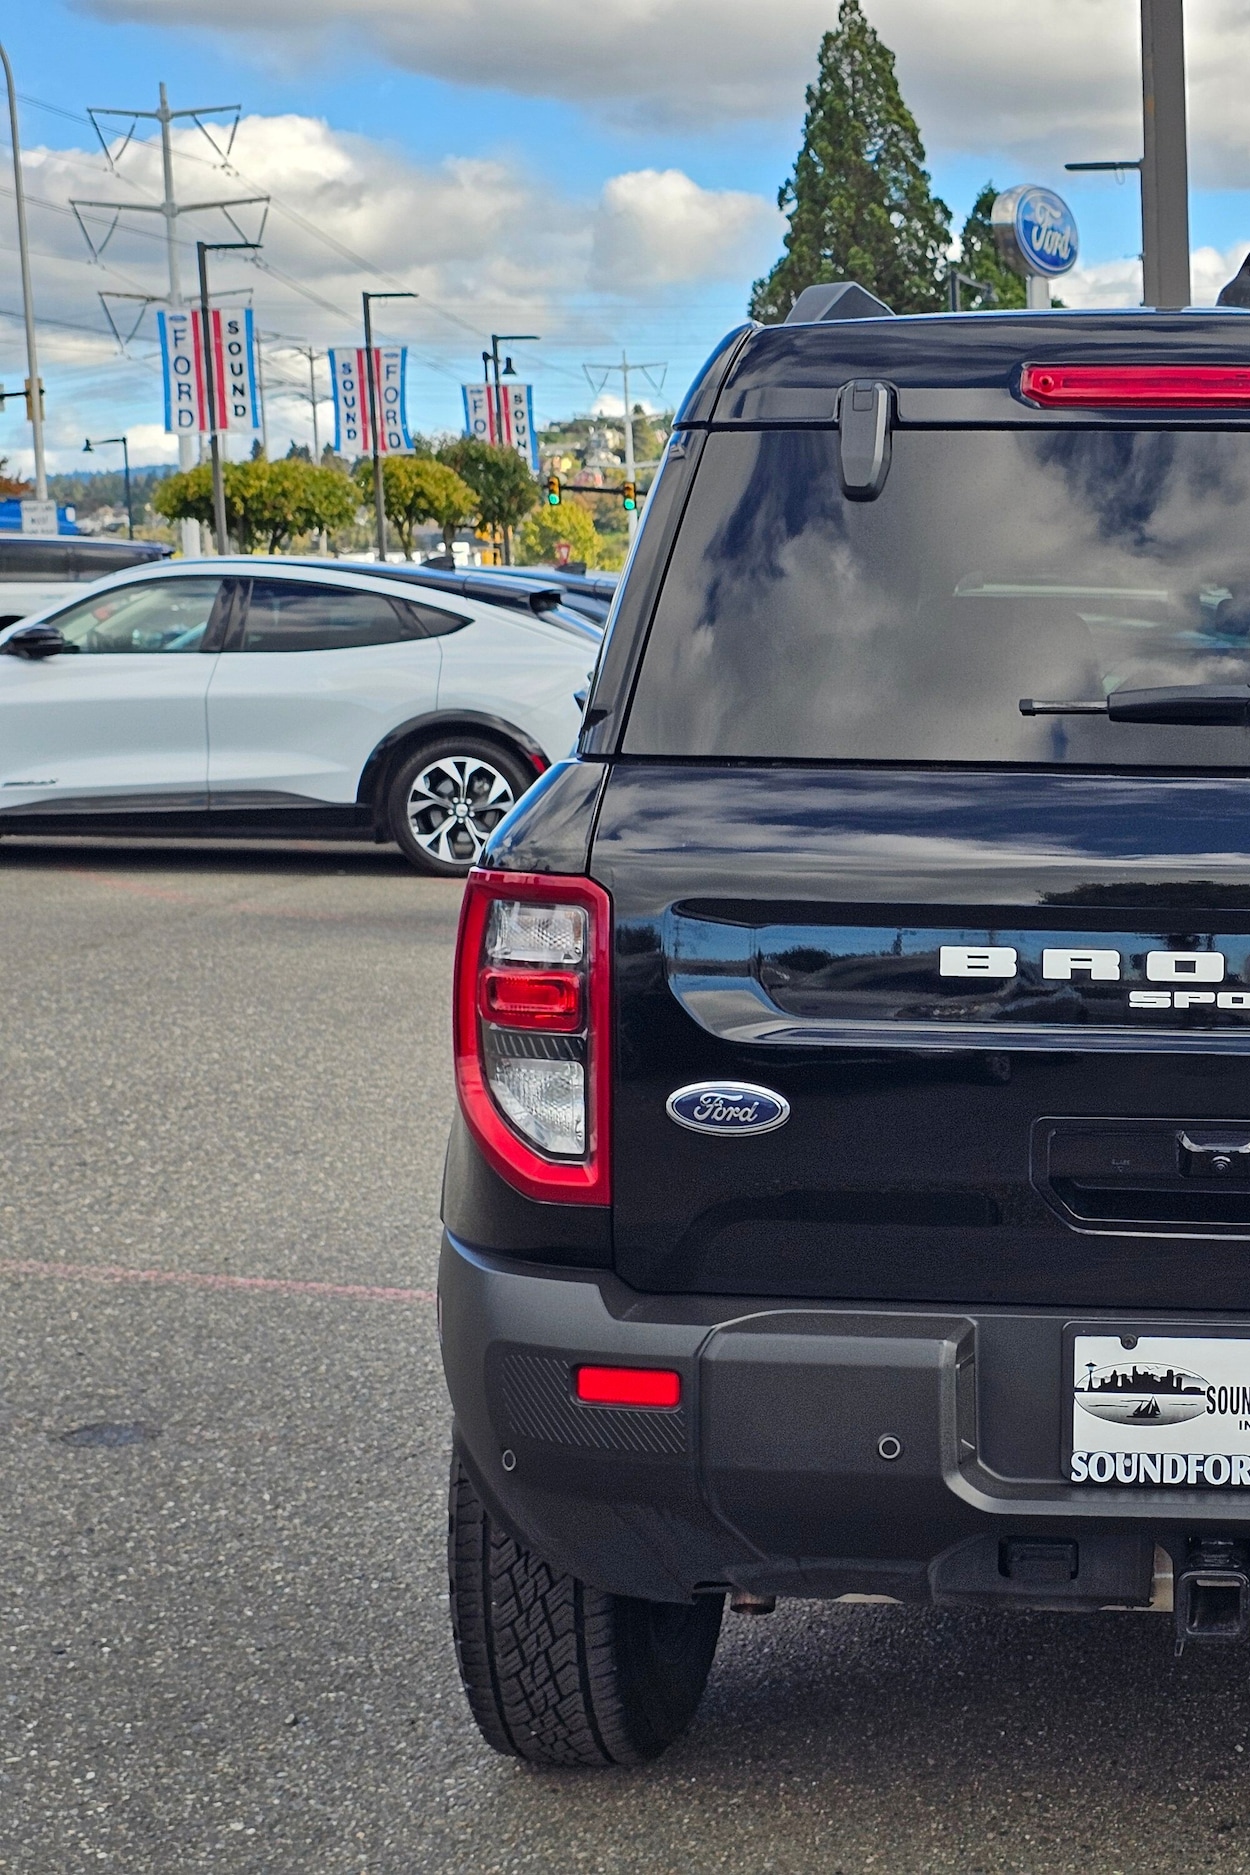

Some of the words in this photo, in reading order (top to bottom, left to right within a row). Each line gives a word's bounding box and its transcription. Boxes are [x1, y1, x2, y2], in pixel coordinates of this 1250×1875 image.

[1031, 202, 1071, 260] Ford
[173, 329, 194, 428] FORD
[227, 321, 246, 417] SOUND
[342, 362, 357, 440] SOUND
[384, 364, 401, 449] FORD
[514, 393, 527, 462] SOUN
[693, 1092, 760, 1122] Ford
